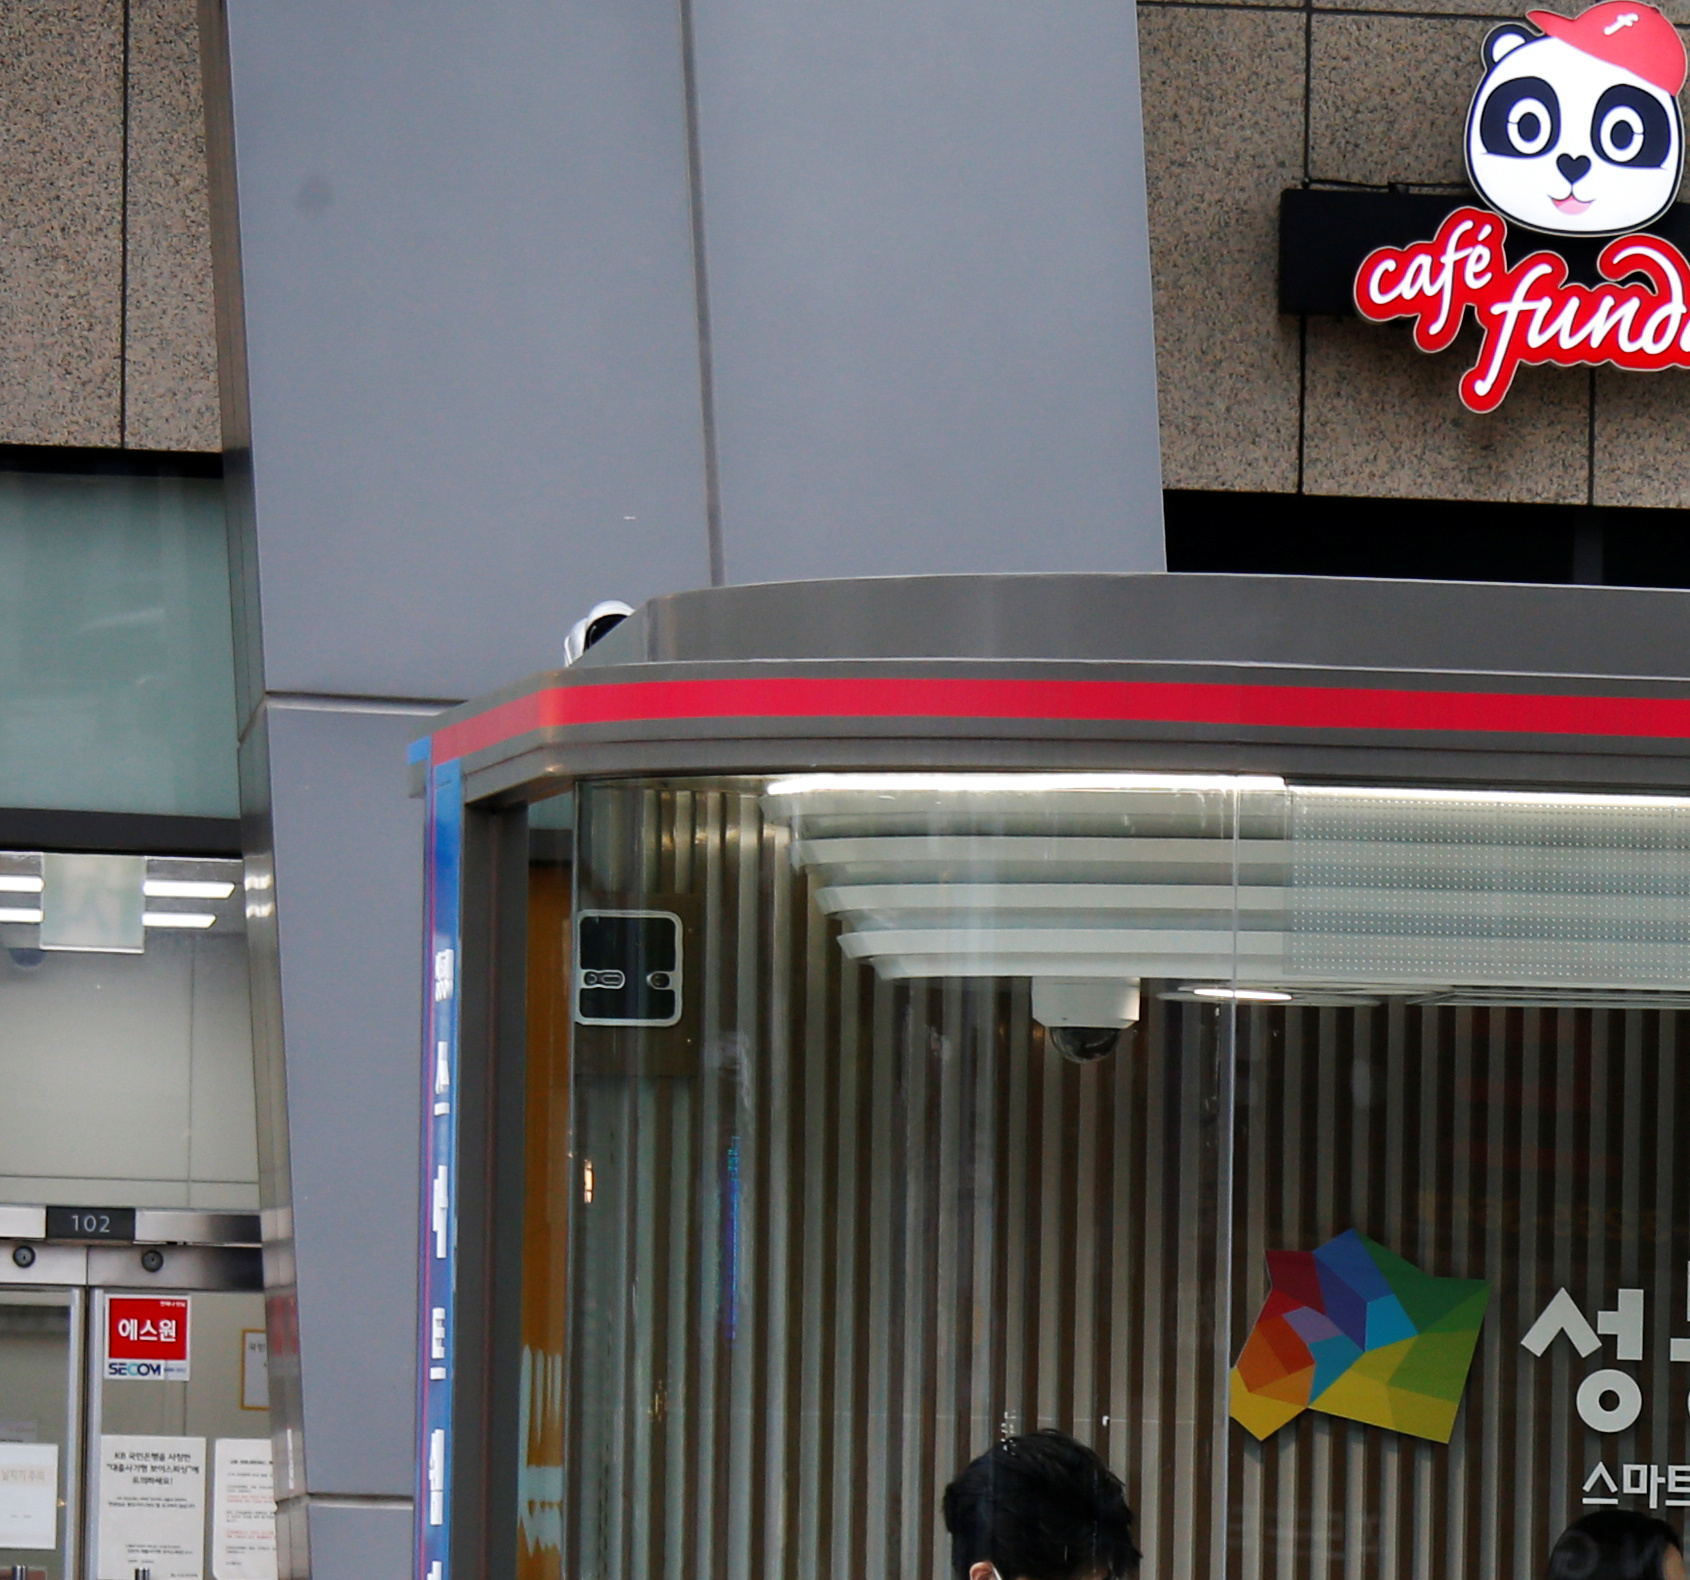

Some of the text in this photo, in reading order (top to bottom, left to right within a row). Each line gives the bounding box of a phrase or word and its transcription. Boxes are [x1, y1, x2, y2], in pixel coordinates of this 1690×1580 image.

[1368, 219, 1493, 336] café
[69, 1214, 112, 1233] 102
[118, 1318, 177, 1343] 에스원
[108, 1363, 162, 1376] SECOM
